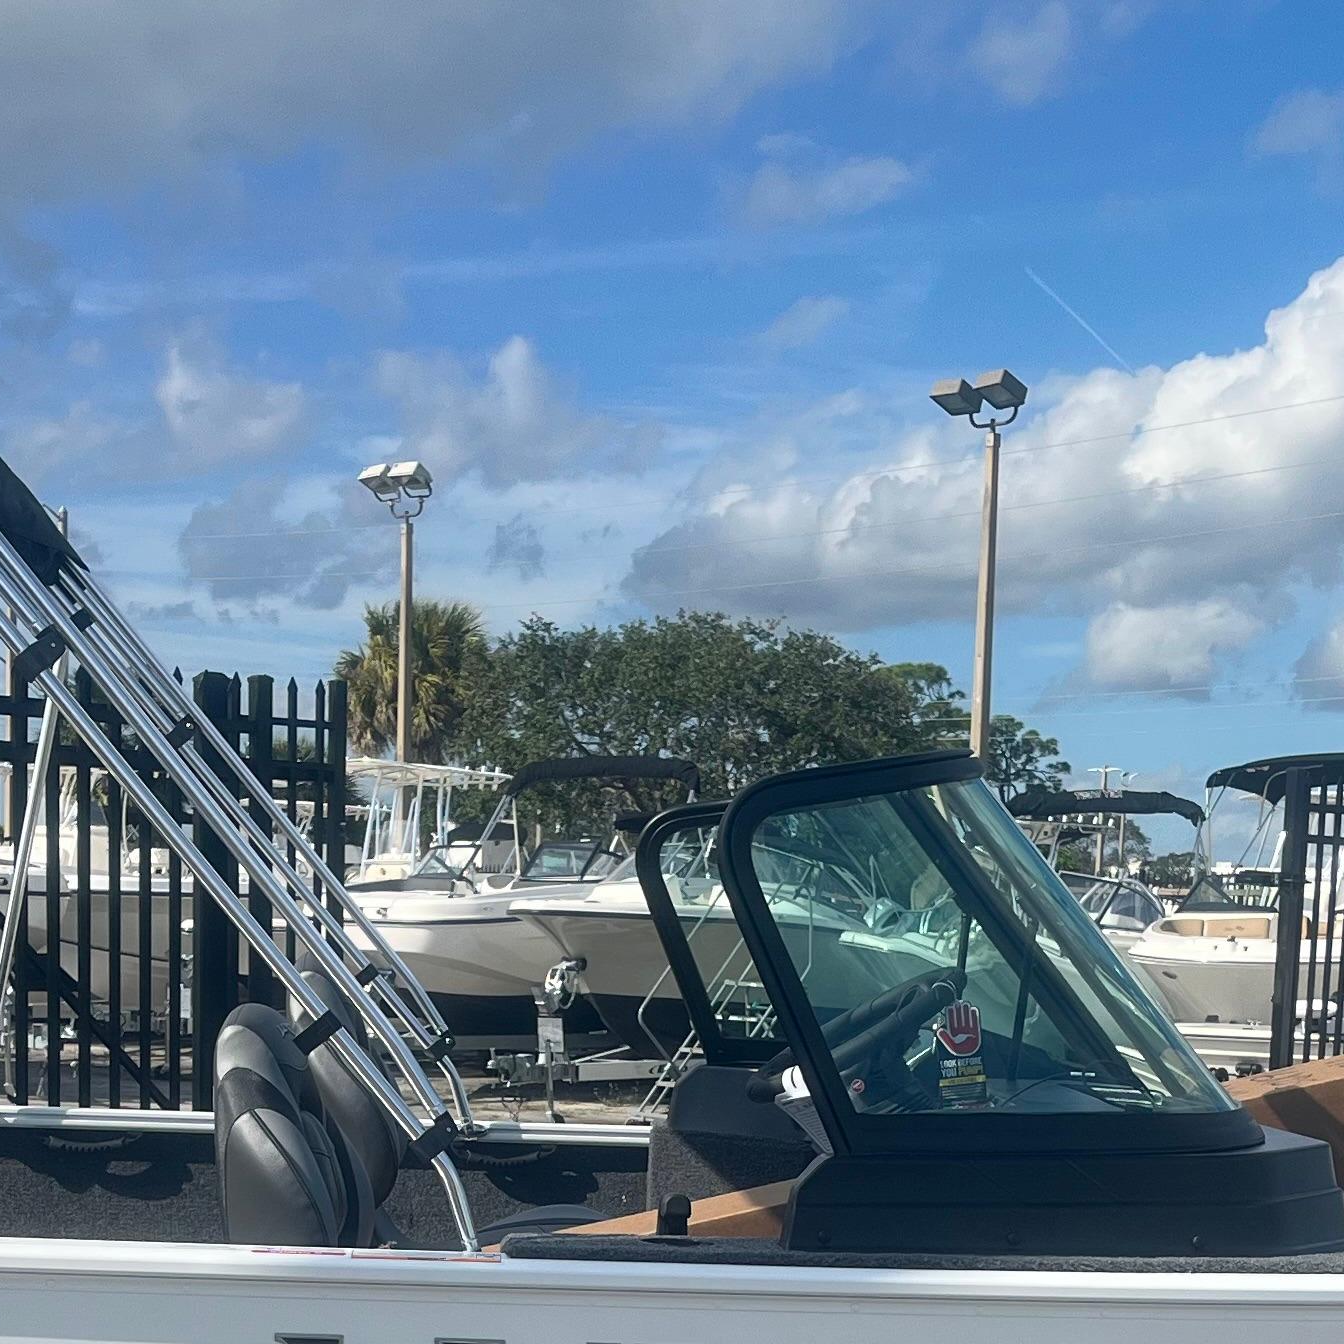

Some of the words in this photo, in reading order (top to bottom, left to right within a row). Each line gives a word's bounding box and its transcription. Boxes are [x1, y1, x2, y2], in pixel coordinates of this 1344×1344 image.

[940, 1059, 957, 1069] LOOK
[957, 1056, 982, 1067] BEFORE
[940, 1066, 957, 1078] YOU
